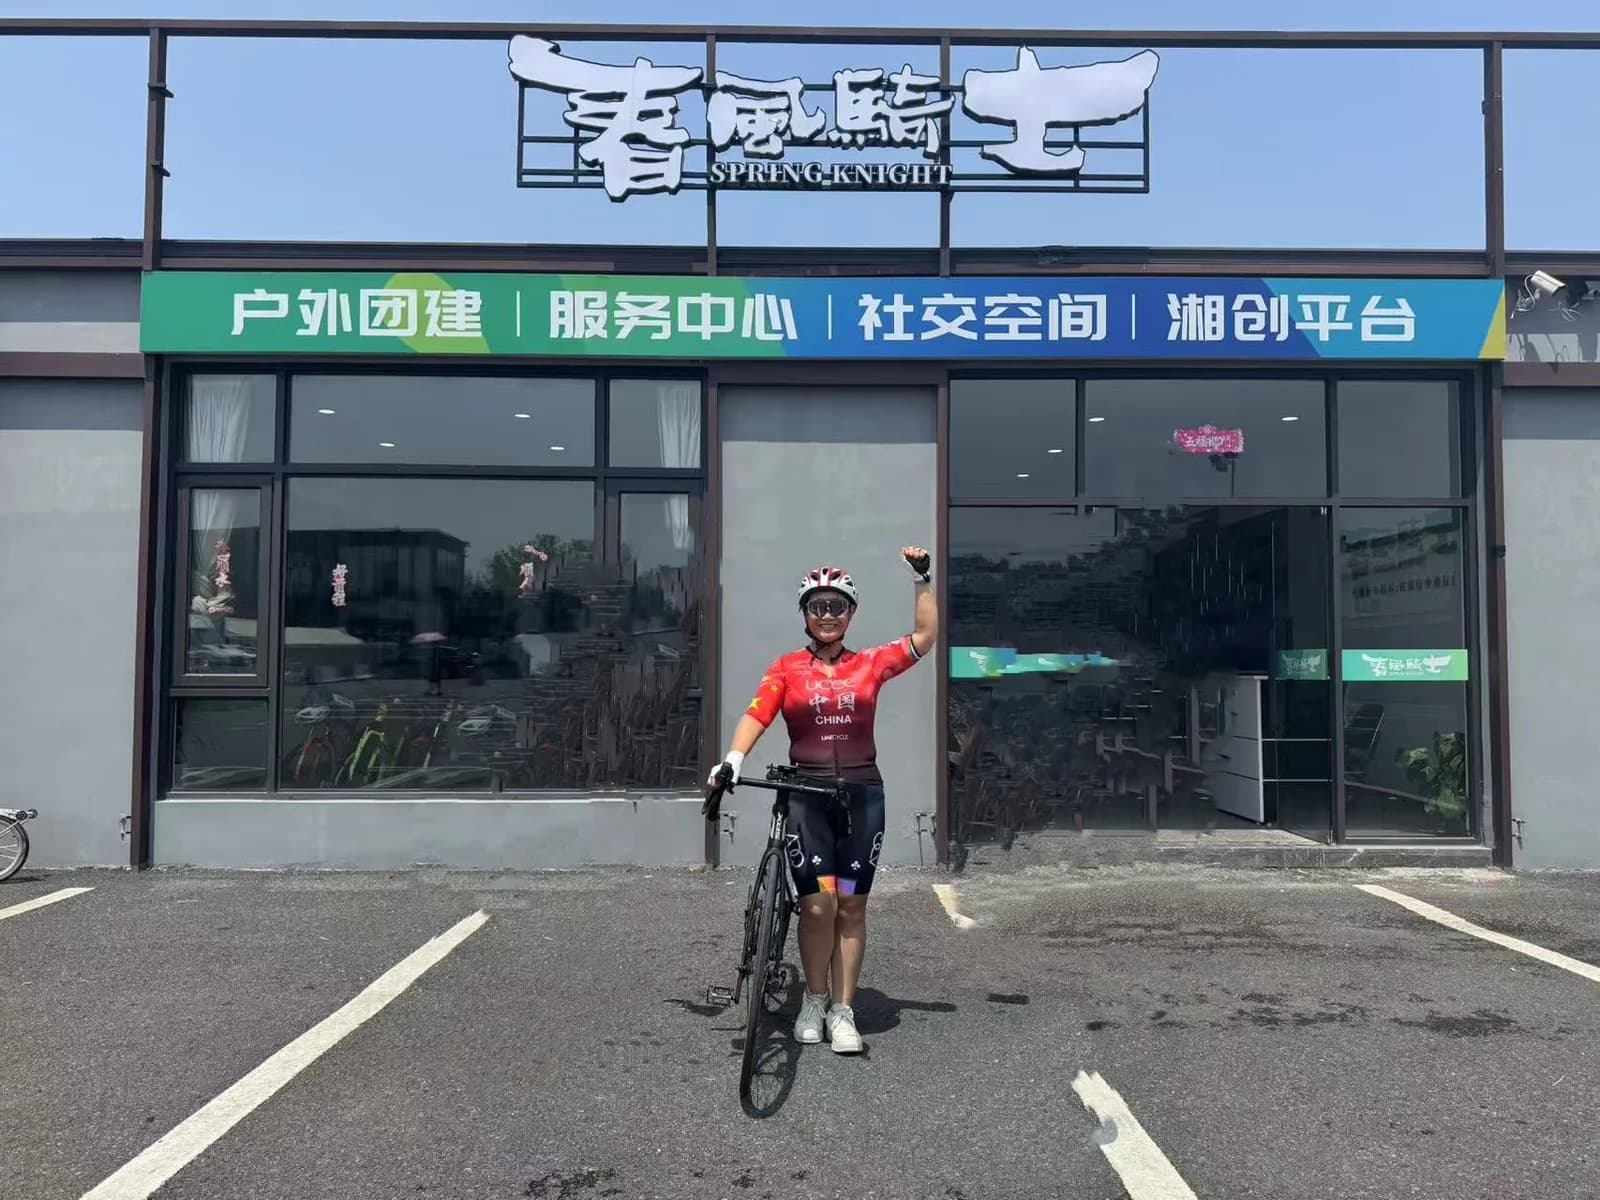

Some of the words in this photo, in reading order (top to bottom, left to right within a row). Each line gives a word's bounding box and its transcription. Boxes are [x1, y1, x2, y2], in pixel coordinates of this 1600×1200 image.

[710, 162, 822, 184] SPRING
[831, 164, 952, 185] KNIGHT
[231, 288, 482, 339] 户外团建
[549, 290, 797, 341] 服务中心
[857, 293, 1107, 342] 社交空间
[1166, 293, 1417, 343] 湘创平台
[808, 692, 855, 713] 中国
[815, 715, 852, 725] CHINA
